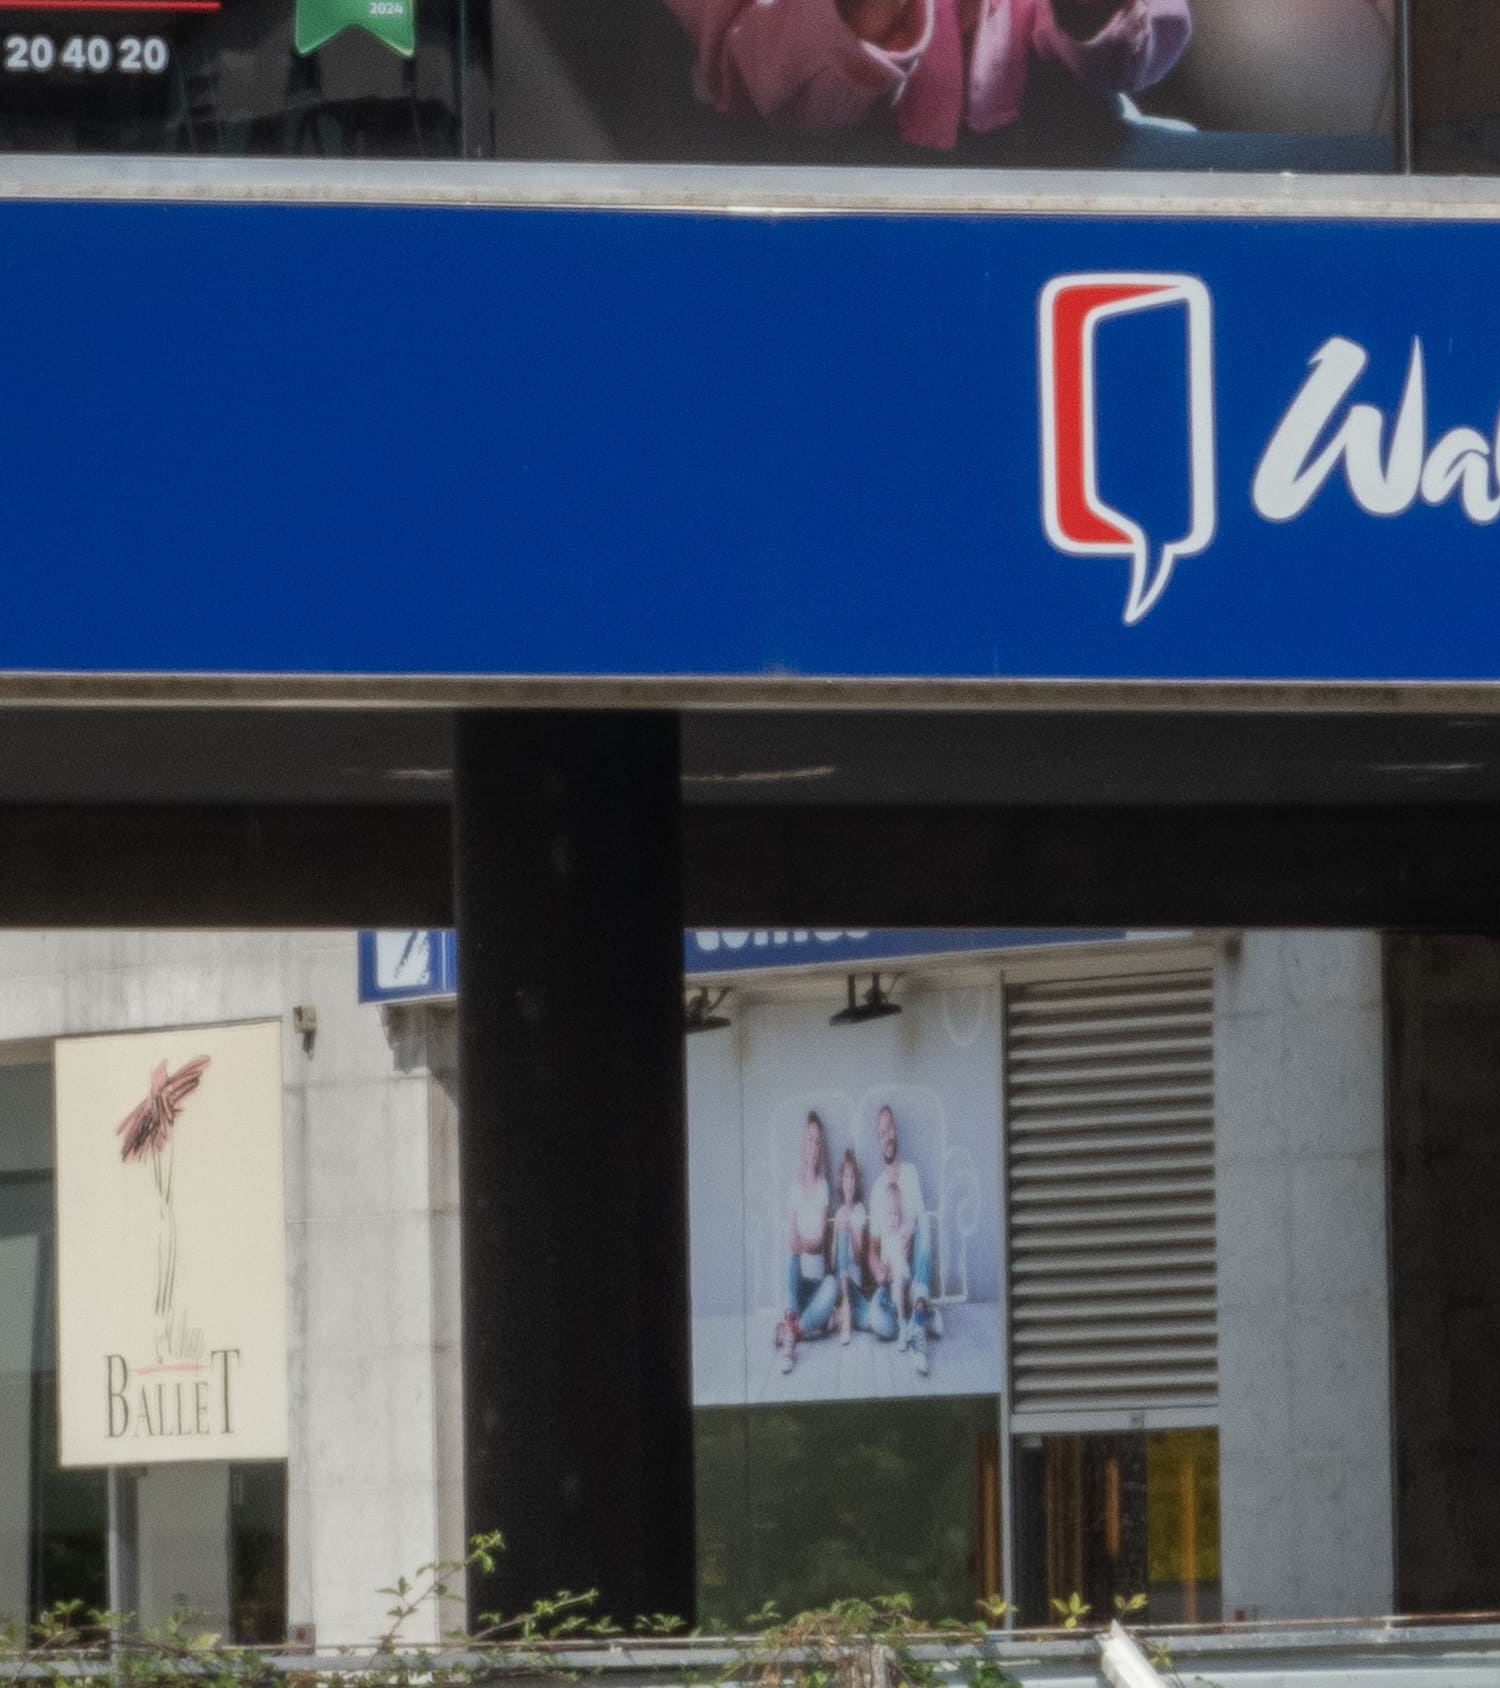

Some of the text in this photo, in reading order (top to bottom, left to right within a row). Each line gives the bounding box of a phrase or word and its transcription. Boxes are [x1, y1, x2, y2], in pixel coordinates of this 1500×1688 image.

[368, 2, 404, 15] 2024
[4, 37, 53, 69] 20
[62, 38, 112, 70] 40
[118, 39, 168, 71] 20
[103, 1349, 240, 1438] BALLET
